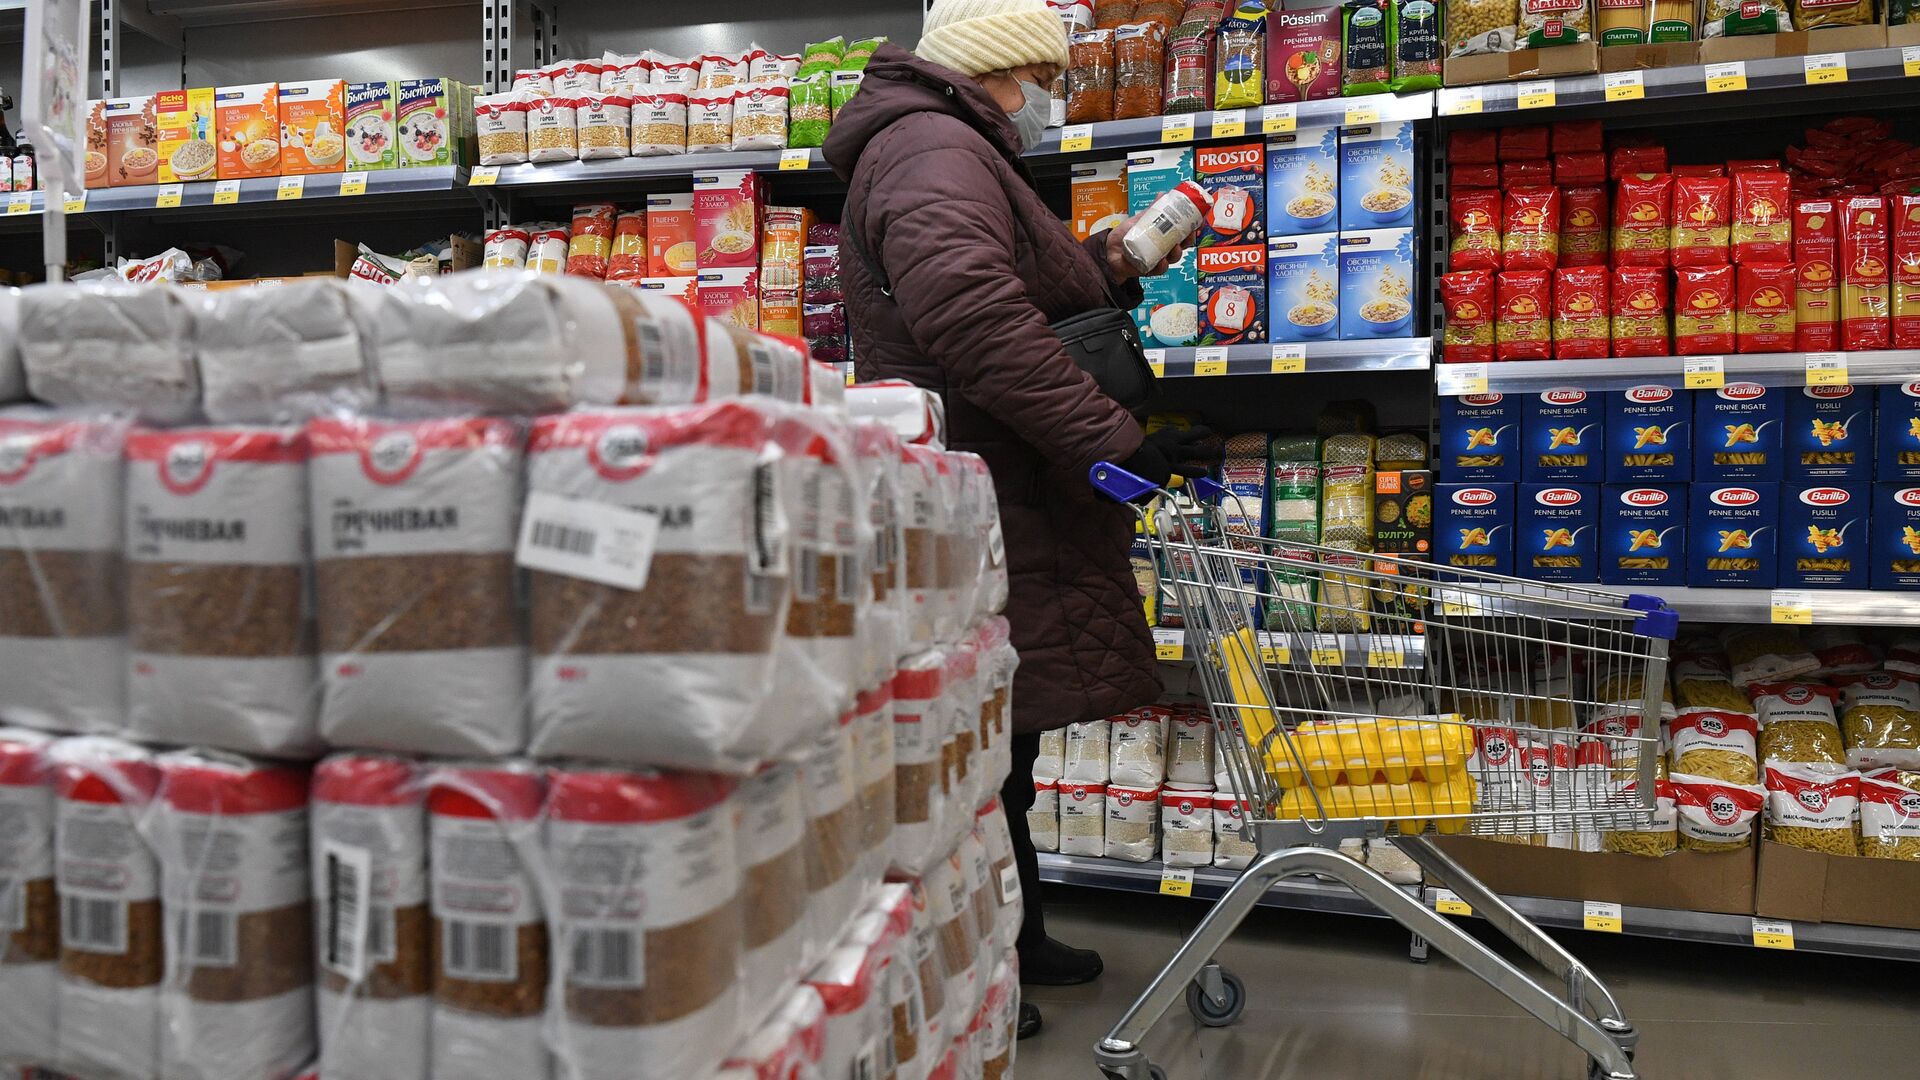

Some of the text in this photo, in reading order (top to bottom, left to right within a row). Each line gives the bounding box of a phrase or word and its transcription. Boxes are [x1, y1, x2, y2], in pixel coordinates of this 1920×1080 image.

[1655, 25, 1689, 33] СПАГЕТТИ
[1283, 35, 1323, 45] ГРЕЧНЕВАЯ
[1400, 35, 1438, 44] ГРЕЧНЕВАЯ
[1606, 32, 1638, 41] СПАГЕТТИ
[1348, 43, 1385, 51] ГРЕЧНЕВАЯ
[1325, 48, 1333, 58] 8
[346, 85, 389, 103] Быстров
[400, 82, 443, 100] Быстров
[1347, 148, 1382, 157] ОВСЯНЫЕ
[1199, 151, 1259, 167] PROSTO
[1273, 154, 1308, 164] ОВСЯНЫЕ
[1347, 155, 1378, 163] ХЛОПЬЯ
[1273, 162, 1303, 170] ХЛОПЬЯ
[1203, 173, 1256, 184] РИС КРАСНОДАРСКИЙ
[1133, 182, 1151, 191] РИС
[1076, 193, 1094, 202] РИС
[1224, 202, 1234, 218] 8
[652, 216, 679, 224] ПШЕНО
[1201, 250, 1261, 266] PROSTO
[1346, 258, 1381, 266] ОВСЯНЫЕ
[1274, 263, 1308, 271] ОВСЯНЫЕ
[1347, 265, 1377, 273] ХЛОПЬЯ
[1275, 269, 1304, 277] ХЛОПЬЯ
[1205, 274, 1258, 284] РИС КРАСНОДАРСКИЙ
[1226, 302, 1235, 317] 8
[1635, 388, 1669, 399] Barilla
[1727, 384, 1762, 395] Barilla
[1550, 390, 1583, 401] Barilla
[1623, 405, 1674, 414] PENNE RIGATE
[1715, 403, 1739, 411] PENNE
[1815, 402, 1841, 410] FUSILLI
[1480, 408, 1504, 416] RIGATE
[1235, 484, 1250, 492] РИС
[1460, 492, 1494, 502] Barilla
[1545, 492, 1579, 502] Barilla
[1630, 492, 1665, 502] Barilla
[1720, 491, 1755, 501] Barilla
[1810, 491, 1845, 501] Barilla
[1451, 508, 1497, 516] PENNE RIGATE
[1377, 531, 1416, 539] БУЛГУР
[1868, 674, 1890, 683] 365
[1701, 719, 1722, 730] 365
[1487, 743, 1506, 753] 365
[1712, 802, 1734, 813] 365
[1691, 827, 1728, 837] МАКАРОННЫЕ
